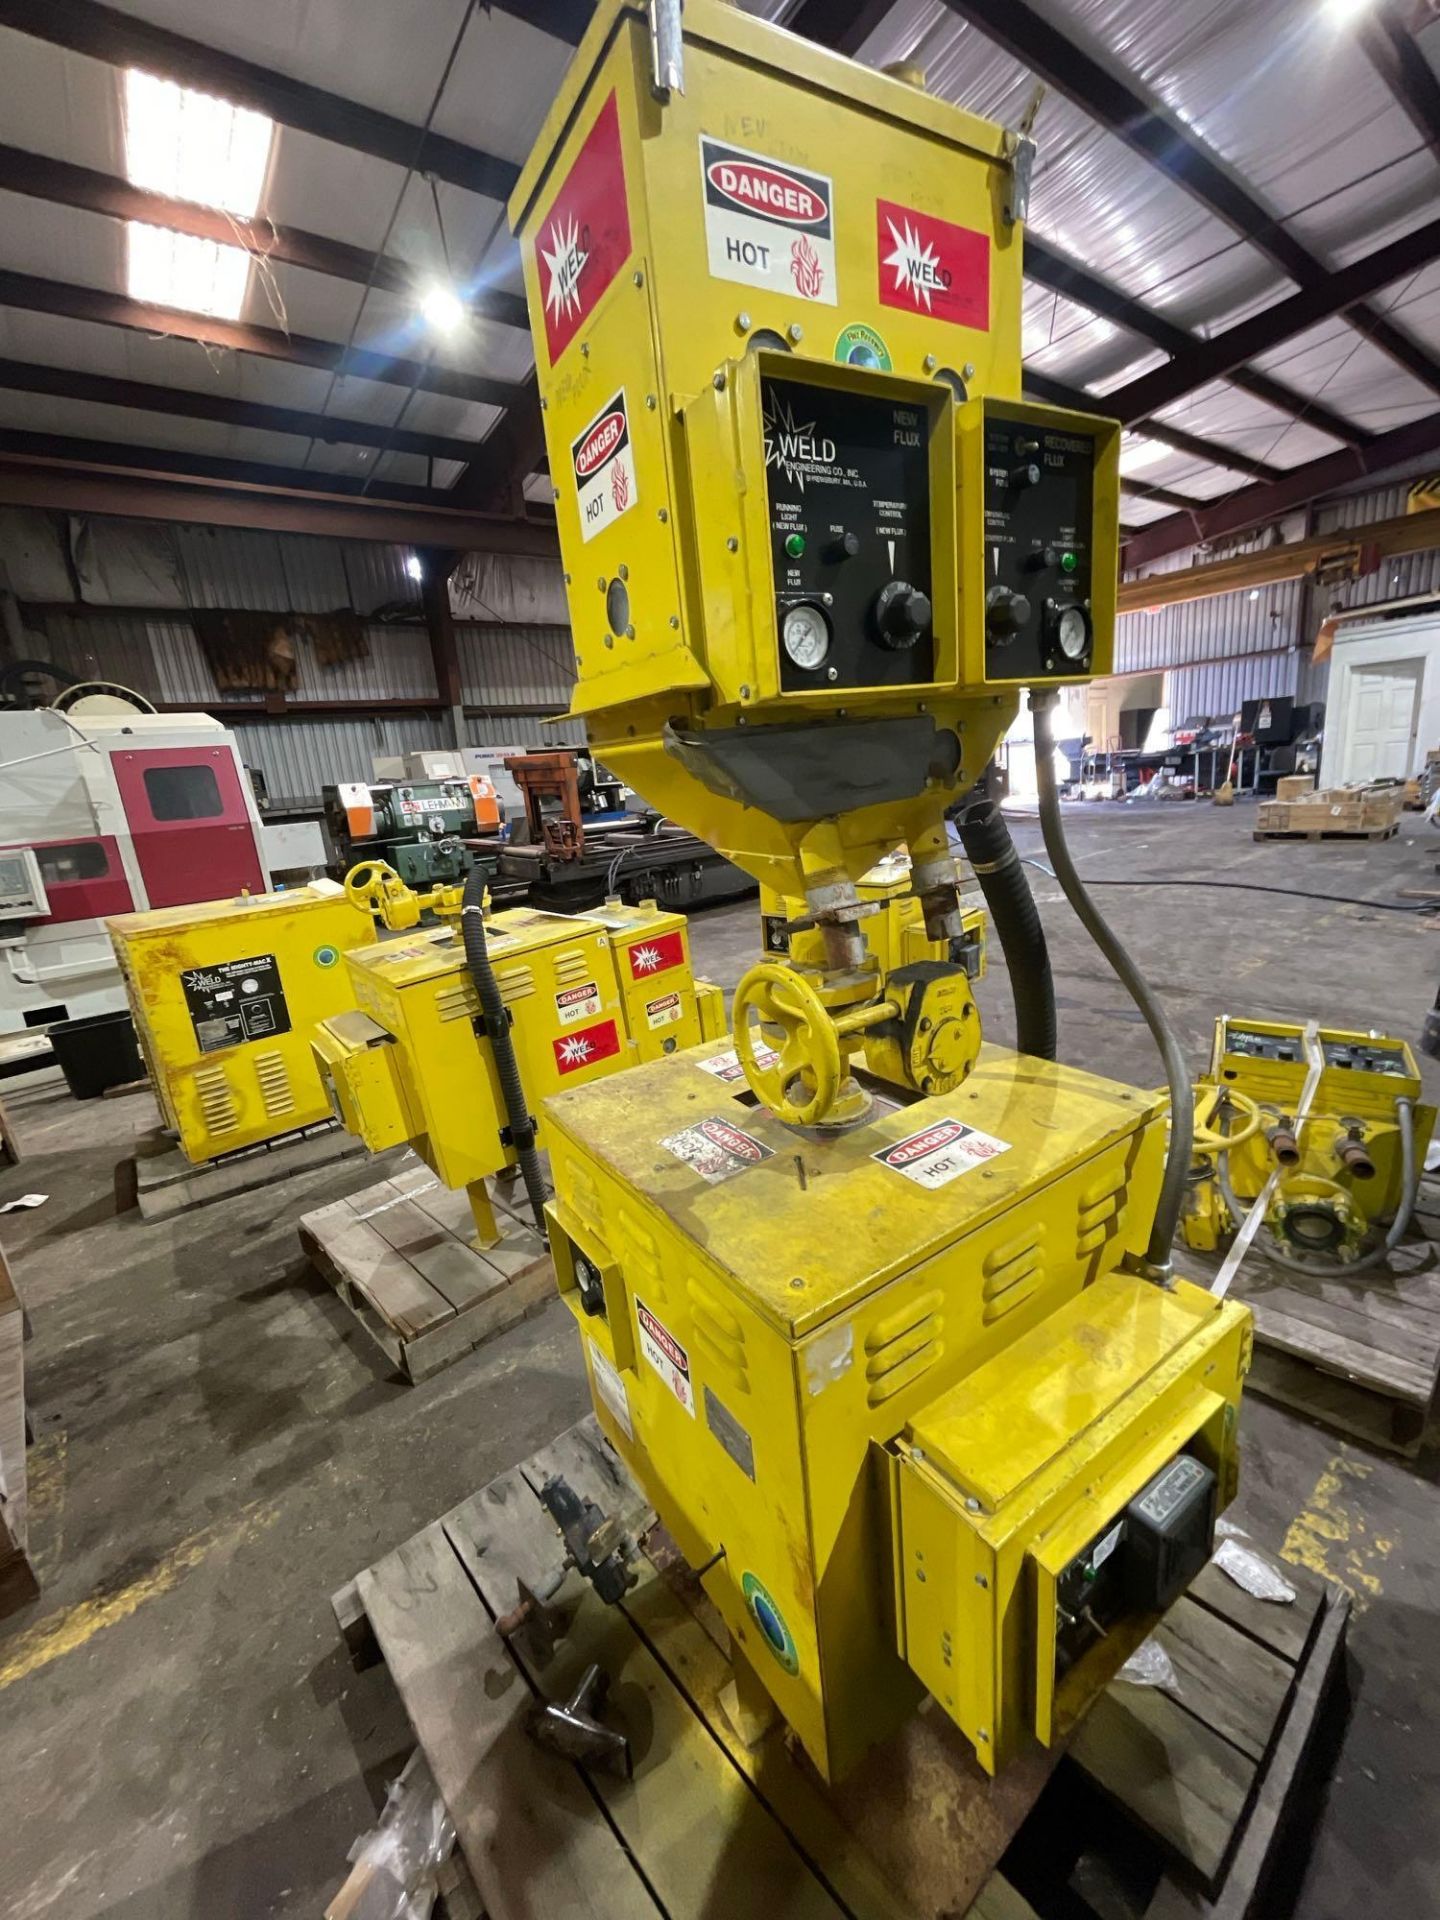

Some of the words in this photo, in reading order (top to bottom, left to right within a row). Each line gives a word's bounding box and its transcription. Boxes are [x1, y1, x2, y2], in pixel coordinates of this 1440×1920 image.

[720, 167, 813, 217] DANGER
[557, 223, 590, 295] WELD
[726, 237, 770, 270] HOT
[907, 258, 953, 289] WELD
[893, 410, 918, 426] NEW
[579, 419, 618, 472] DANGER
[779, 432, 836, 462] WELD
[893, 431, 920, 448] FLUX
[785, 461, 832, 475] ENGINEERING
[1043, 452, 1065, 467] FLUX
[586, 493, 604, 523] HOT
[776, 502, 802, 513] RUNNING
[781, 512, 798, 521] LIGHT
[787, 569, 801, 577] NEW
[199, 976, 221, 987] WELD
[560, 986, 593, 1004] DANGER
[650, 995, 676, 1012] DANGER
[565, 1008, 580, 1019] HOT
[653, 1015, 665, 1025] HOT
[571, 1042, 596, 1056] WELD
[705, 1124, 757, 1160] DANGER
[893, 1127, 958, 1160] DANGER
[923, 1157, 958, 1177] HOT
[642, 1312, 683, 1366] DANGER
[646, 1342, 664, 1369] HOT
